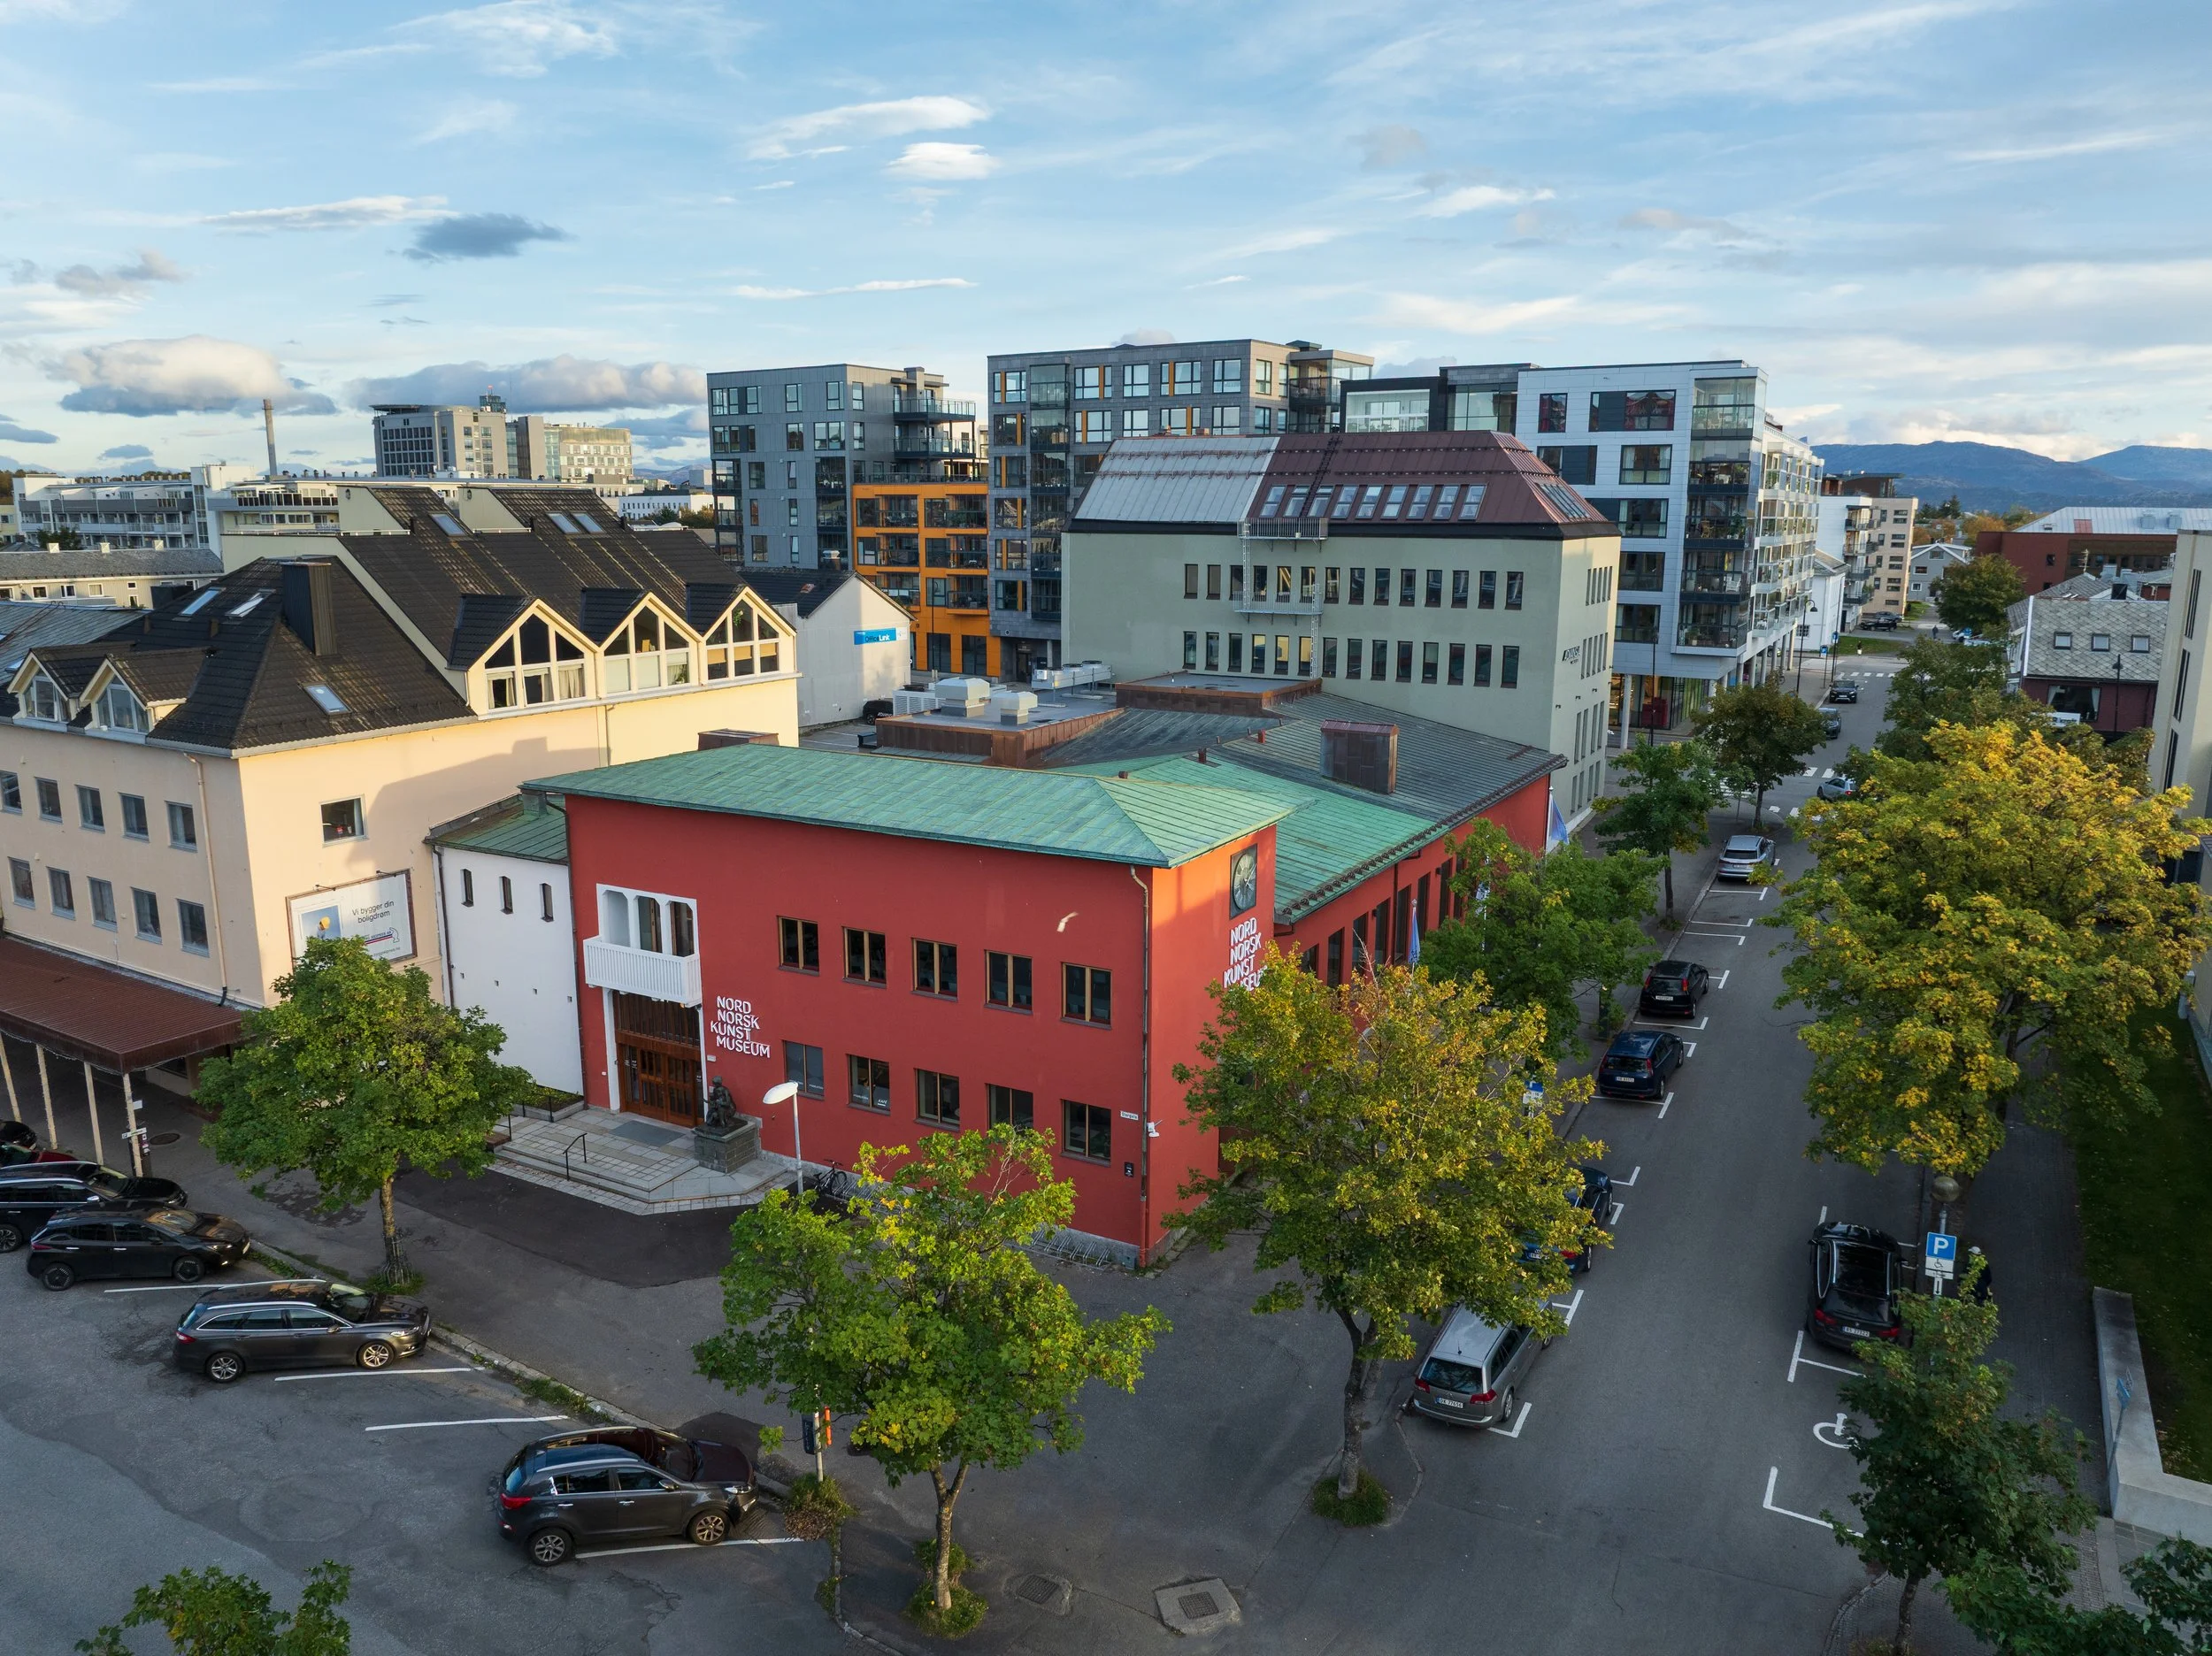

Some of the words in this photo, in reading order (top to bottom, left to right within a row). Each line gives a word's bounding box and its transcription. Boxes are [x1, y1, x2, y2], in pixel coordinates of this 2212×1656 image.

[357, 910, 390, 924] boligdrøm
[360, 903, 383, 915] bygger
[1230, 917, 1257, 947] NORD
[1230, 932, 1262, 965] NORSK
[1223, 954, 1256, 988] KUNST
[717, 995, 752, 1015] NORD
[717, 1009, 761, 1030] NORSK
[710, 1021, 752, 1041] KUNST
[716, 1036, 771, 1058] MUSEUM
[1933, 1237, 1949, 1255] P
